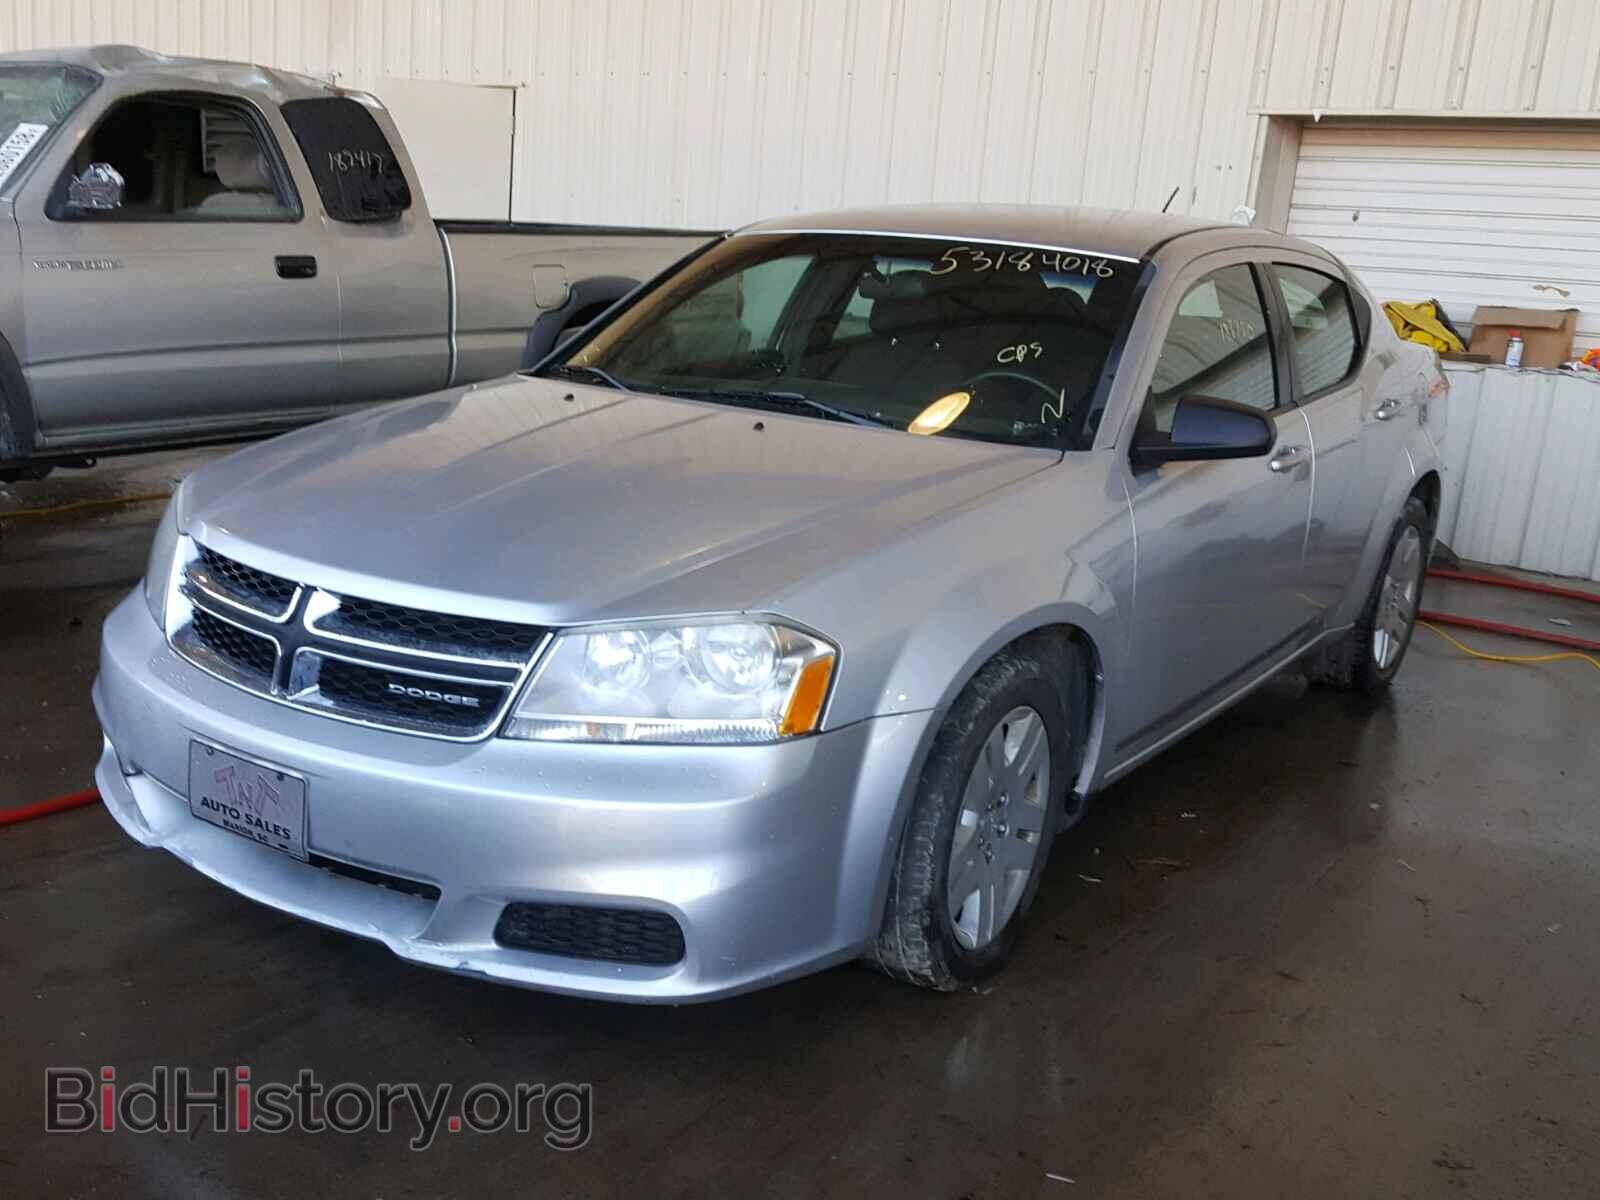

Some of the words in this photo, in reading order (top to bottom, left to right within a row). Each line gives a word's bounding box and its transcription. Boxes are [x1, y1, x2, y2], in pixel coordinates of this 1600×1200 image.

[388, 683, 481, 708] DODGE
[201, 797, 240, 819] AUTO
[245, 813, 291, 840] SALES
